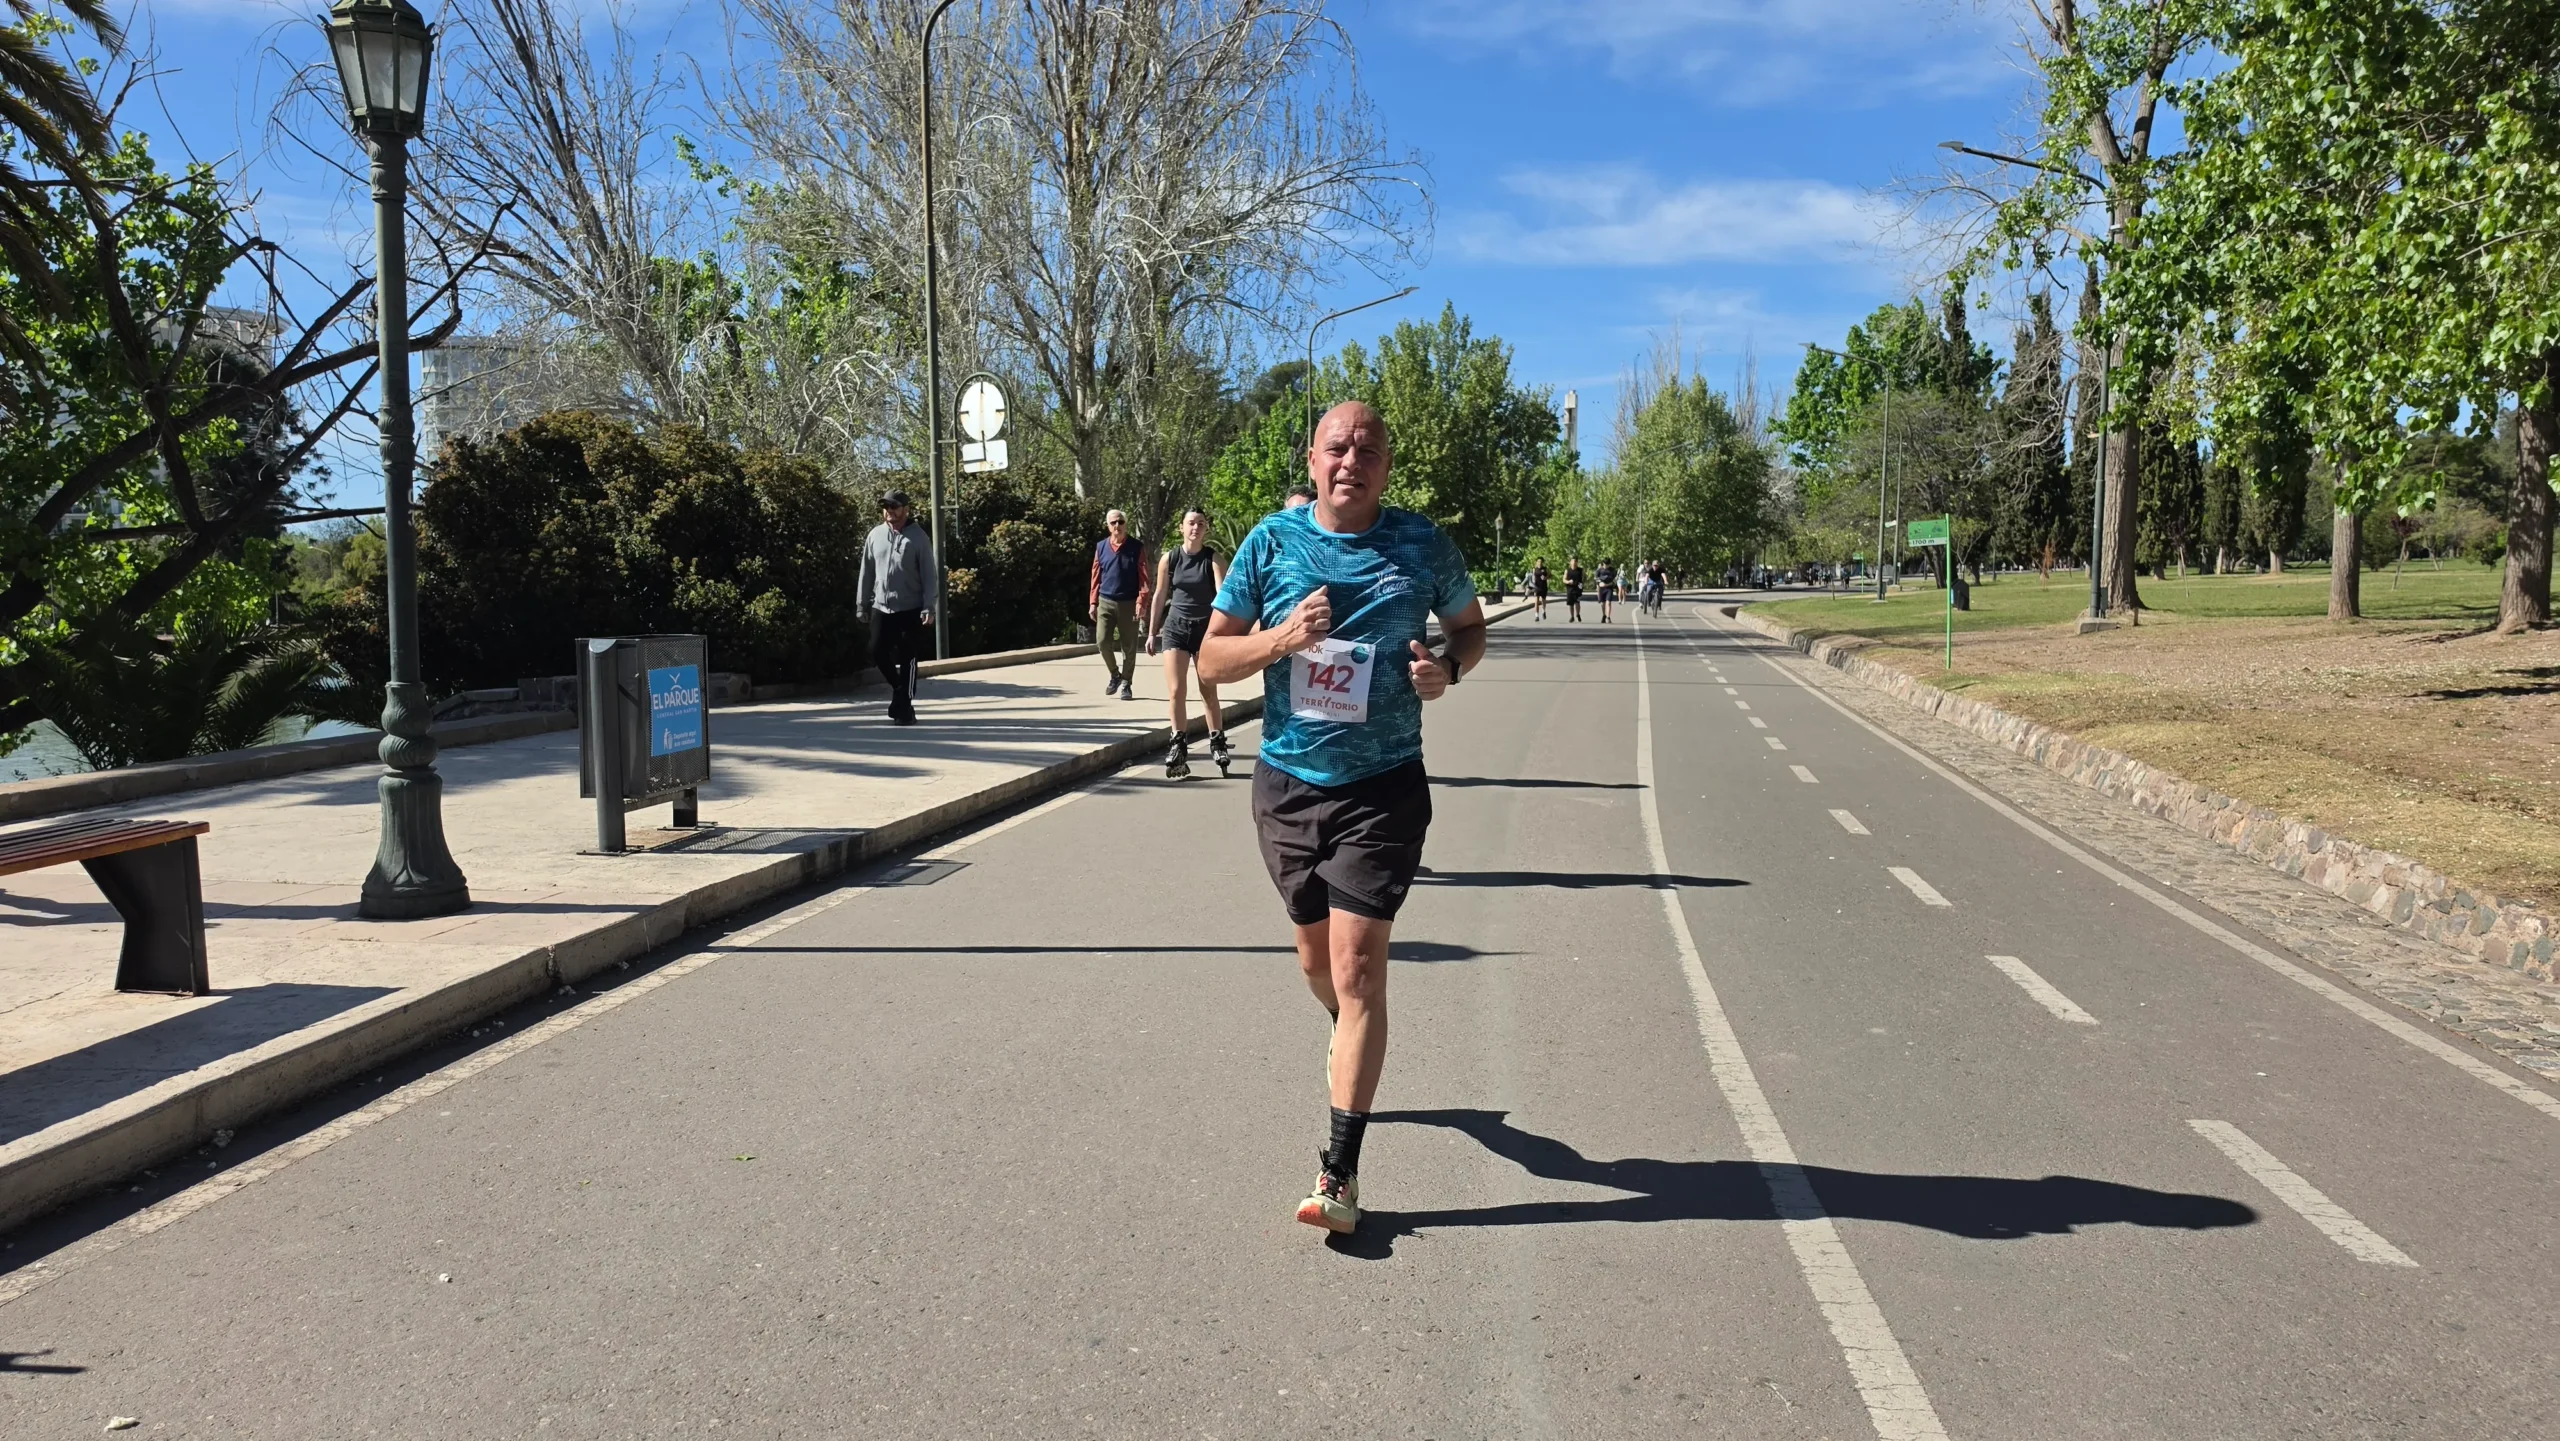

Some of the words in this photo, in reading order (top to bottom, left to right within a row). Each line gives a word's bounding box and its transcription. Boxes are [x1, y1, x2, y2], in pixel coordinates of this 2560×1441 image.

[1307, 661, 1355, 694] 142
[653, 693, 664, 710] EL
[664, 688, 699, 708] PARQUE
[1300, 696, 1359, 712] TERRITORIO
[656, 711, 674, 719] GENERAL
